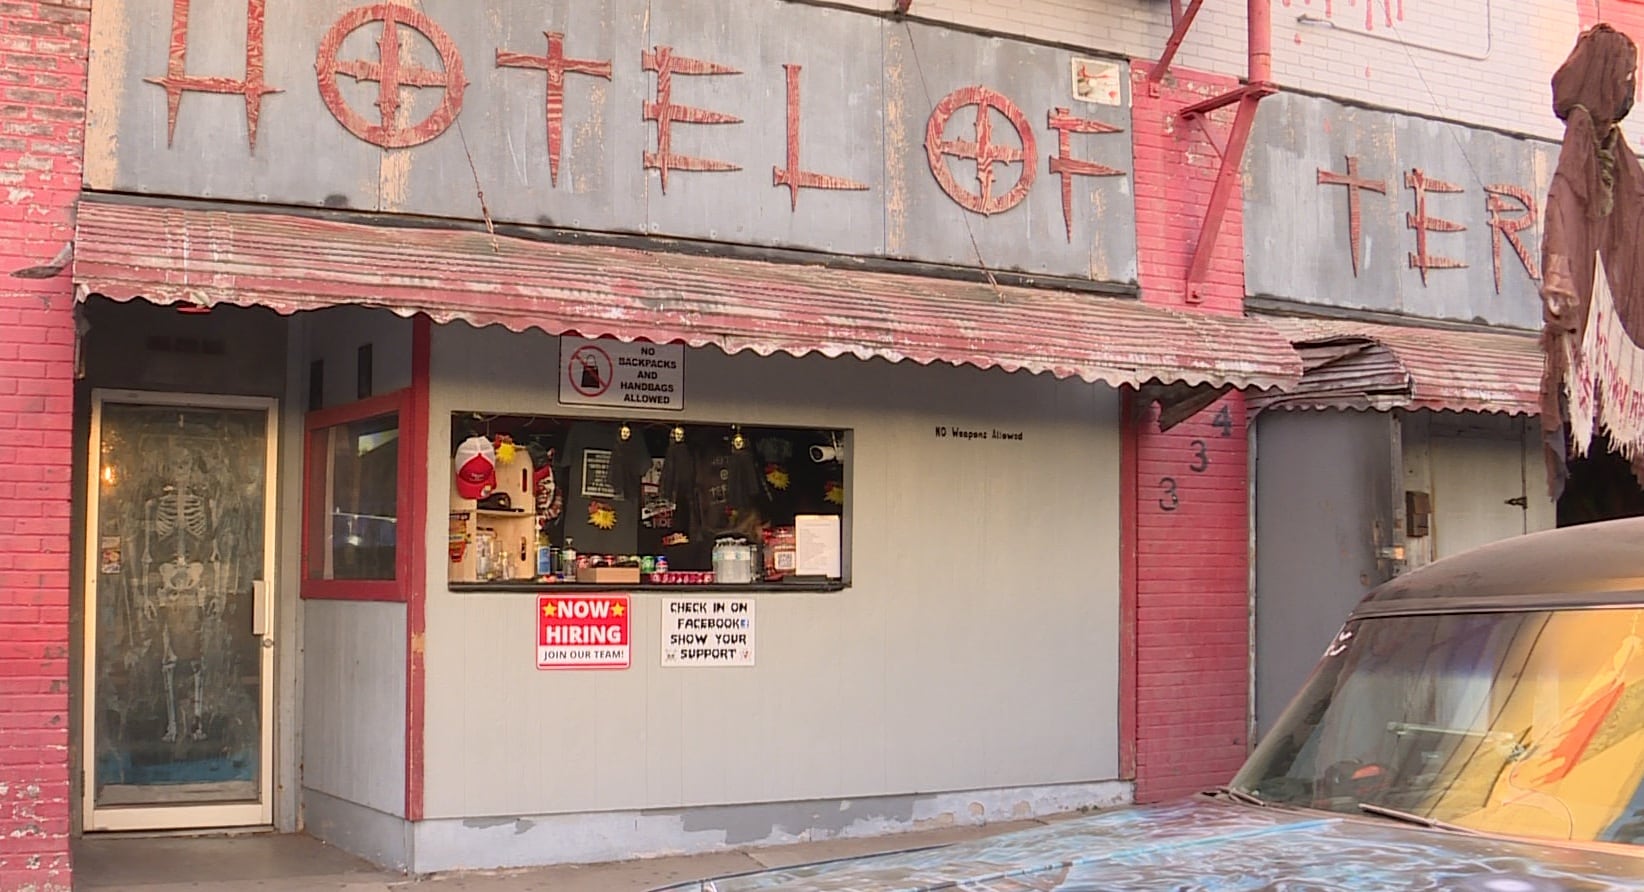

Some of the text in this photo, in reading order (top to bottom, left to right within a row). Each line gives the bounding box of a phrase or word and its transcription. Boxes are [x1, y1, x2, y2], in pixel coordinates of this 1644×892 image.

[143, 0, 1127, 244] HOTEL OF
[641, 347, 655, 356] NO
[618, 357, 677, 369] BACKPACKS
[637, 370, 658, 379] AND
[620, 381, 674, 392] HANDBAGS
[624, 394, 670, 404] ALLOWED
[935, 426, 1023, 440] NO Weapons Allowed
[557, 600, 610, 619] NOW
[670, 602, 748, 613] CHECK IN ON
[677, 618, 740, 629] FACEBOOK
[546, 625, 621, 643] HIRING
[670, 634, 747, 645] SHOW YOUR
[543, 650, 624, 661] JOIN OUR TEAM!
[680, 648, 737, 659] SUPPORT
